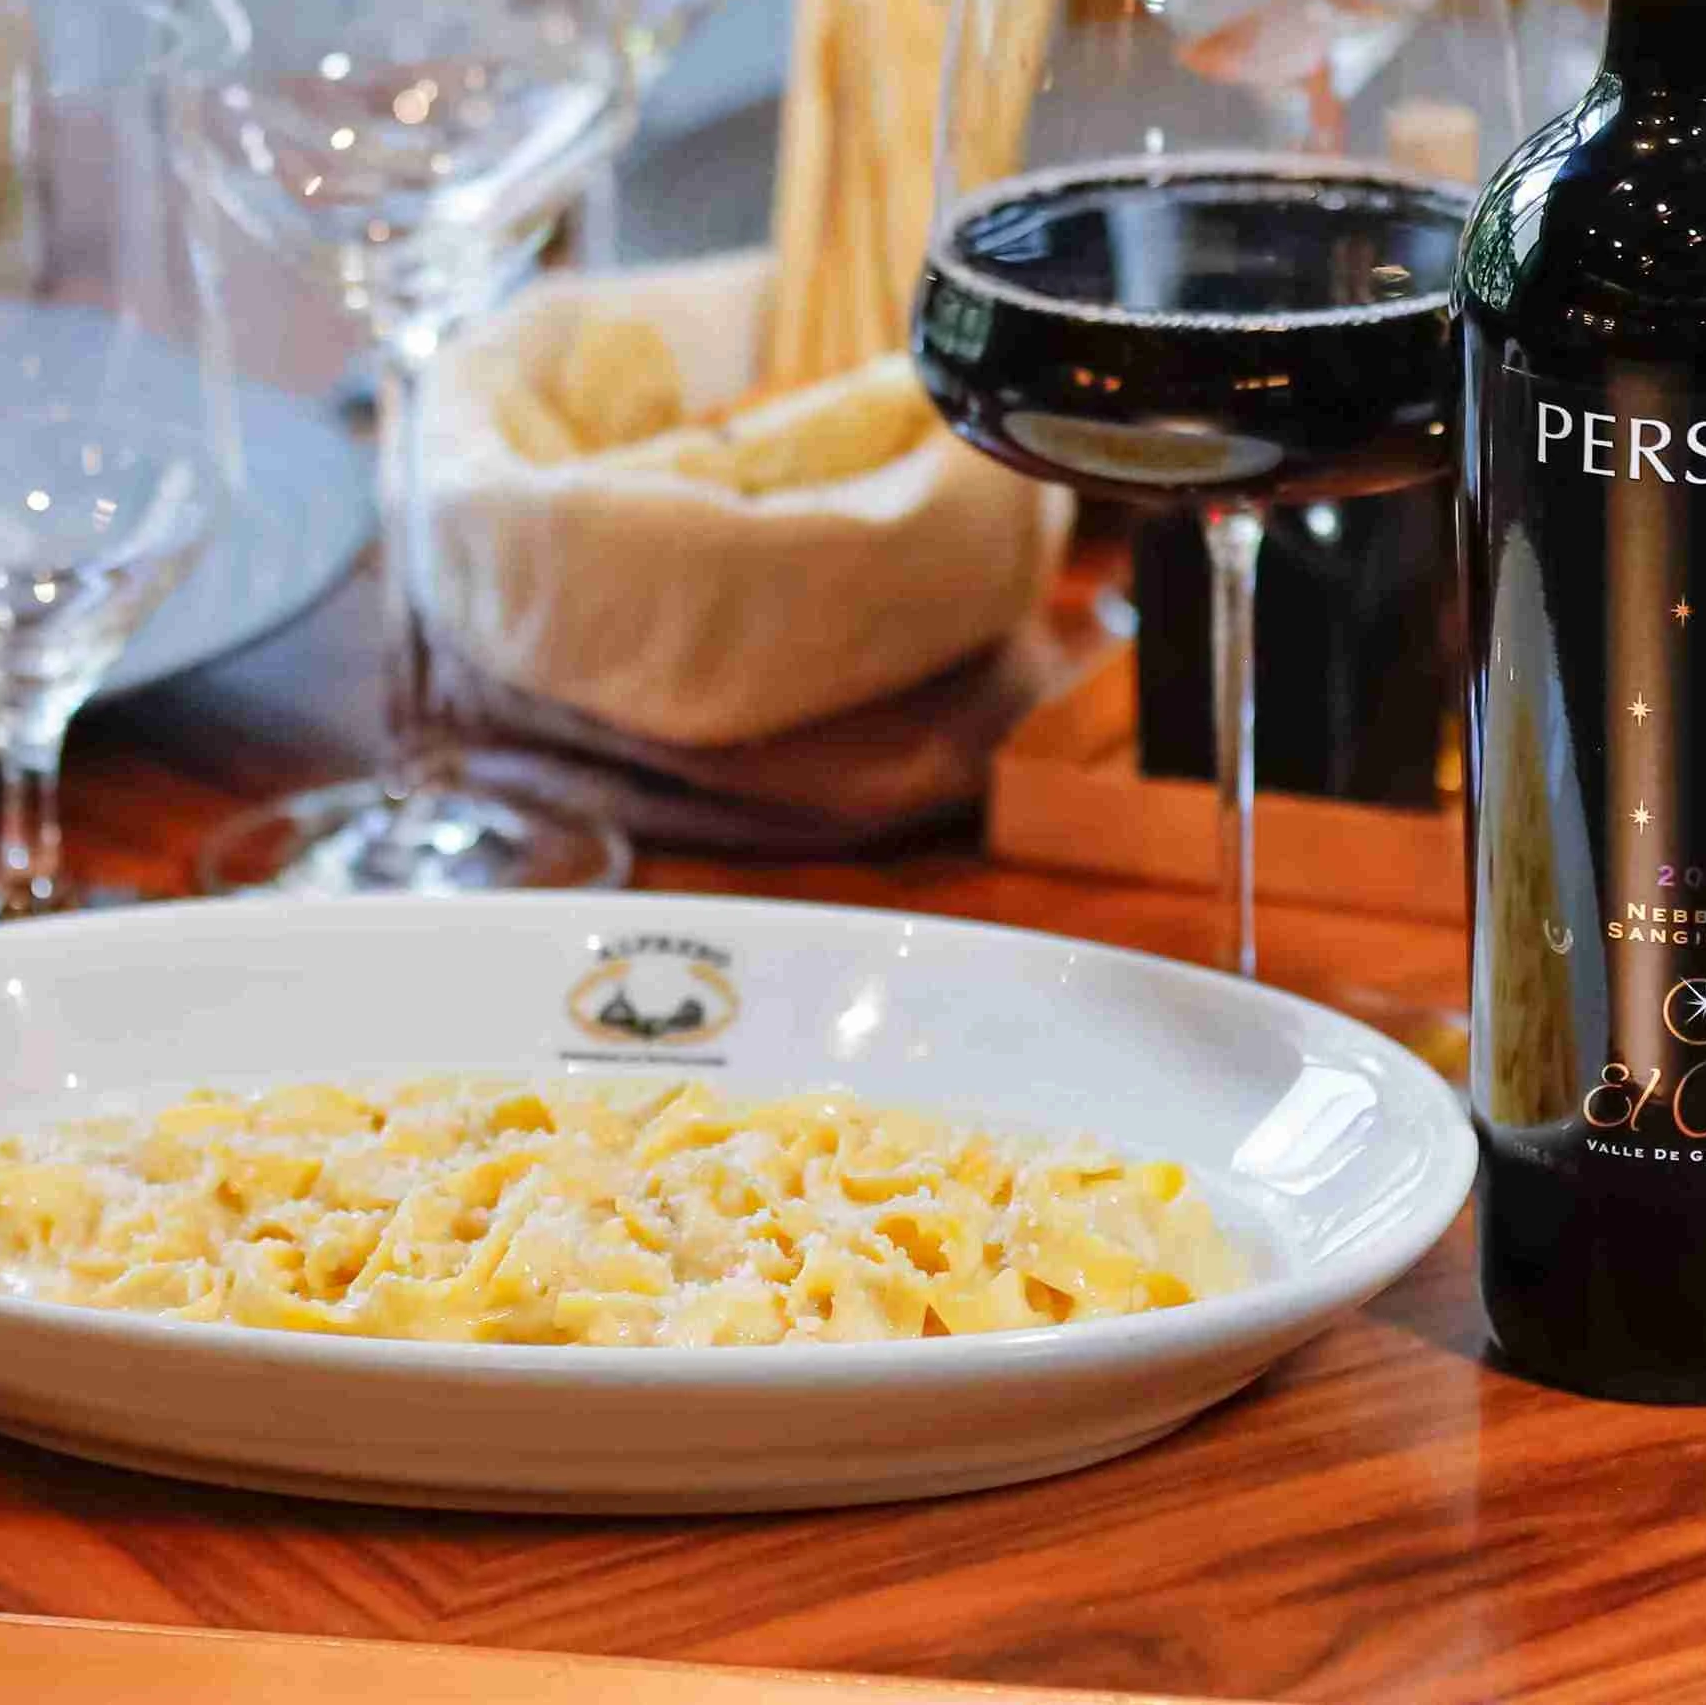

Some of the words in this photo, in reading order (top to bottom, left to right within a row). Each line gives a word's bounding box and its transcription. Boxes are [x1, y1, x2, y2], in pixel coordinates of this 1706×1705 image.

[1583, 1062, 1662, 1132] El
[1586, 1138, 1645, 1159] VALLE
[1654, 1148, 1681, 1162] DE
